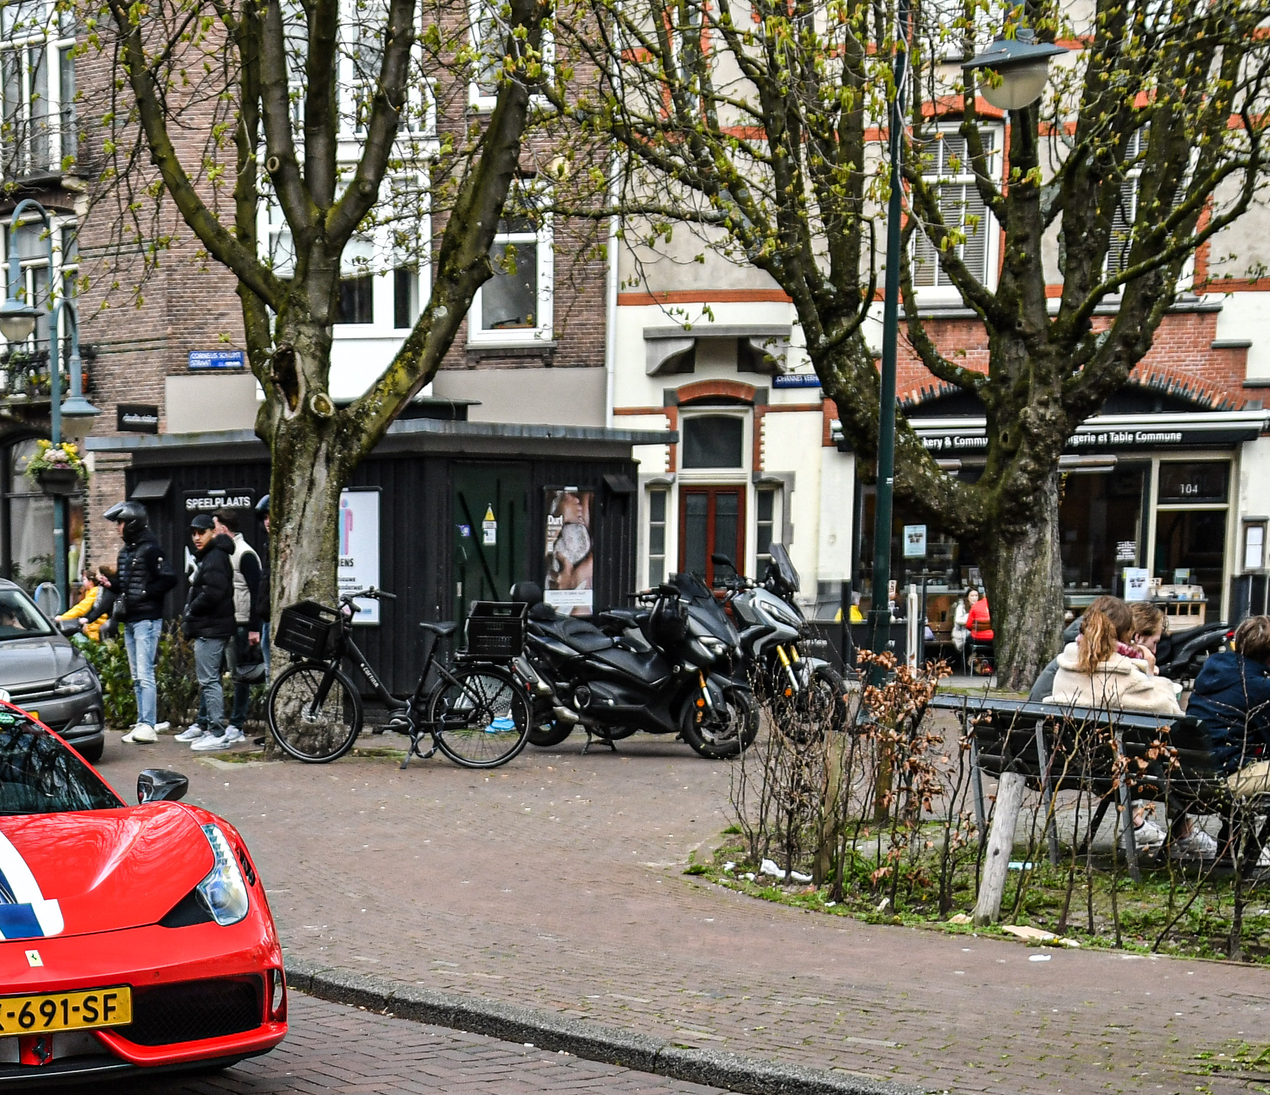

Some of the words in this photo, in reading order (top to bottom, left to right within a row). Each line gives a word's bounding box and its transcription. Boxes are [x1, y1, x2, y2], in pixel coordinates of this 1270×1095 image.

[944, 437, 952, 446] &
[1098, 433, 1108, 441] et
[1109, 432, 1134, 441] Table
[1136, 432, 1182, 441] Commune
[1180, 483, 1198, 494] 104
[186, 496, 251, 509] SPEELPLAATS
